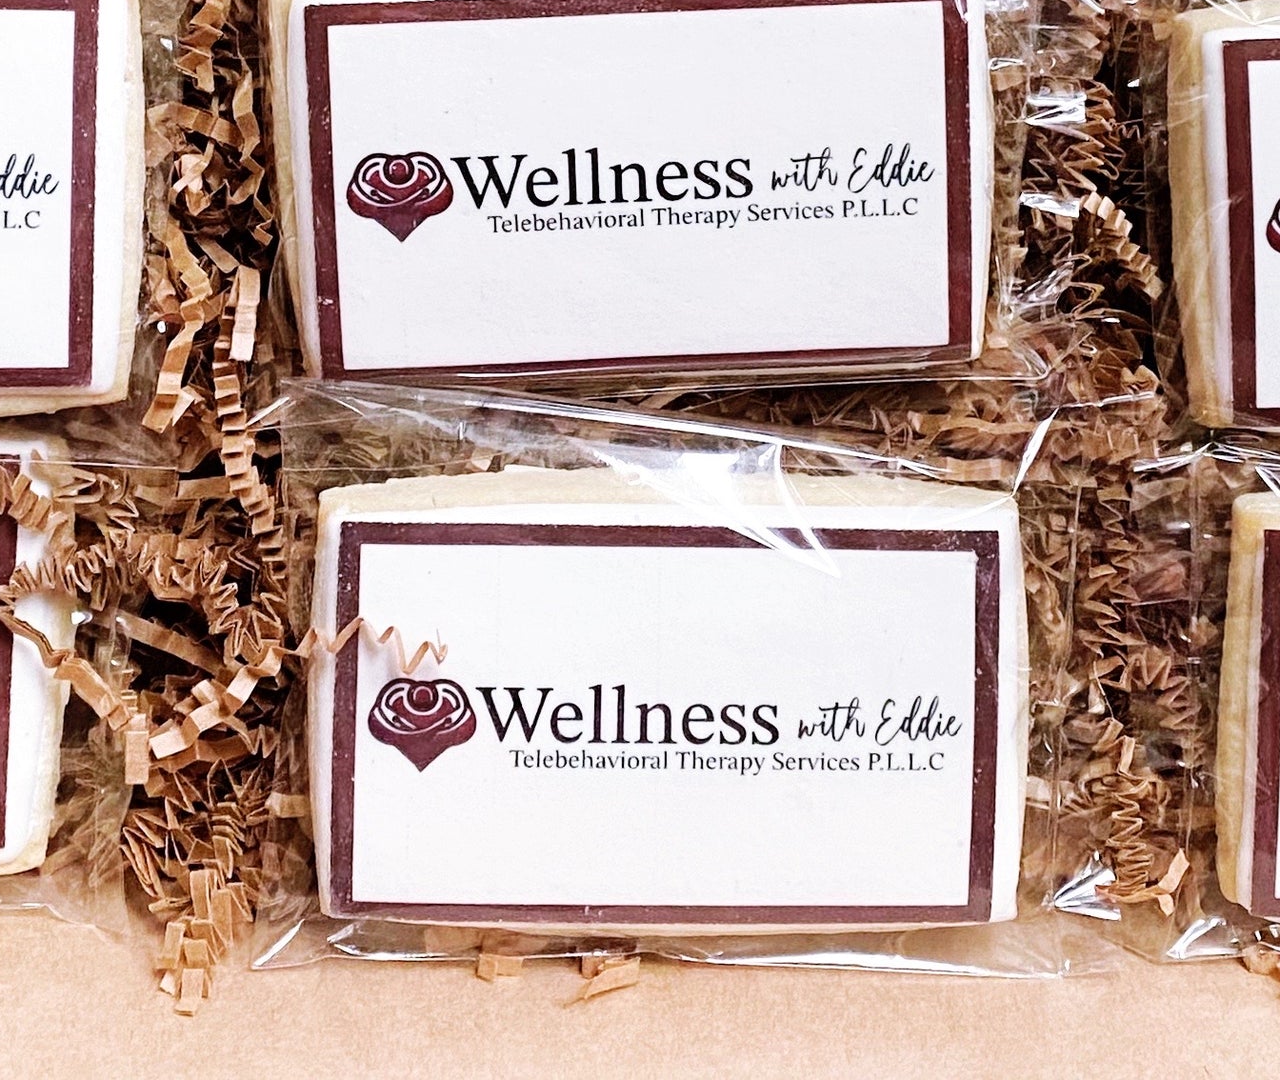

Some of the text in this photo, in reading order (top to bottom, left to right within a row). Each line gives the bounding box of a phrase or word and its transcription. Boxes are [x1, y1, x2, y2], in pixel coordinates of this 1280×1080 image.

[450, 143, 935, 209] Wellness with Eddie
[487, 198, 918, 233] Telebehavioral Therapy Services P.L.L.C
[475, 684, 962, 746] Wellness with Eddie
[509, 750, 944, 776] Telebehavioral Therapy Services P.L.L.C
